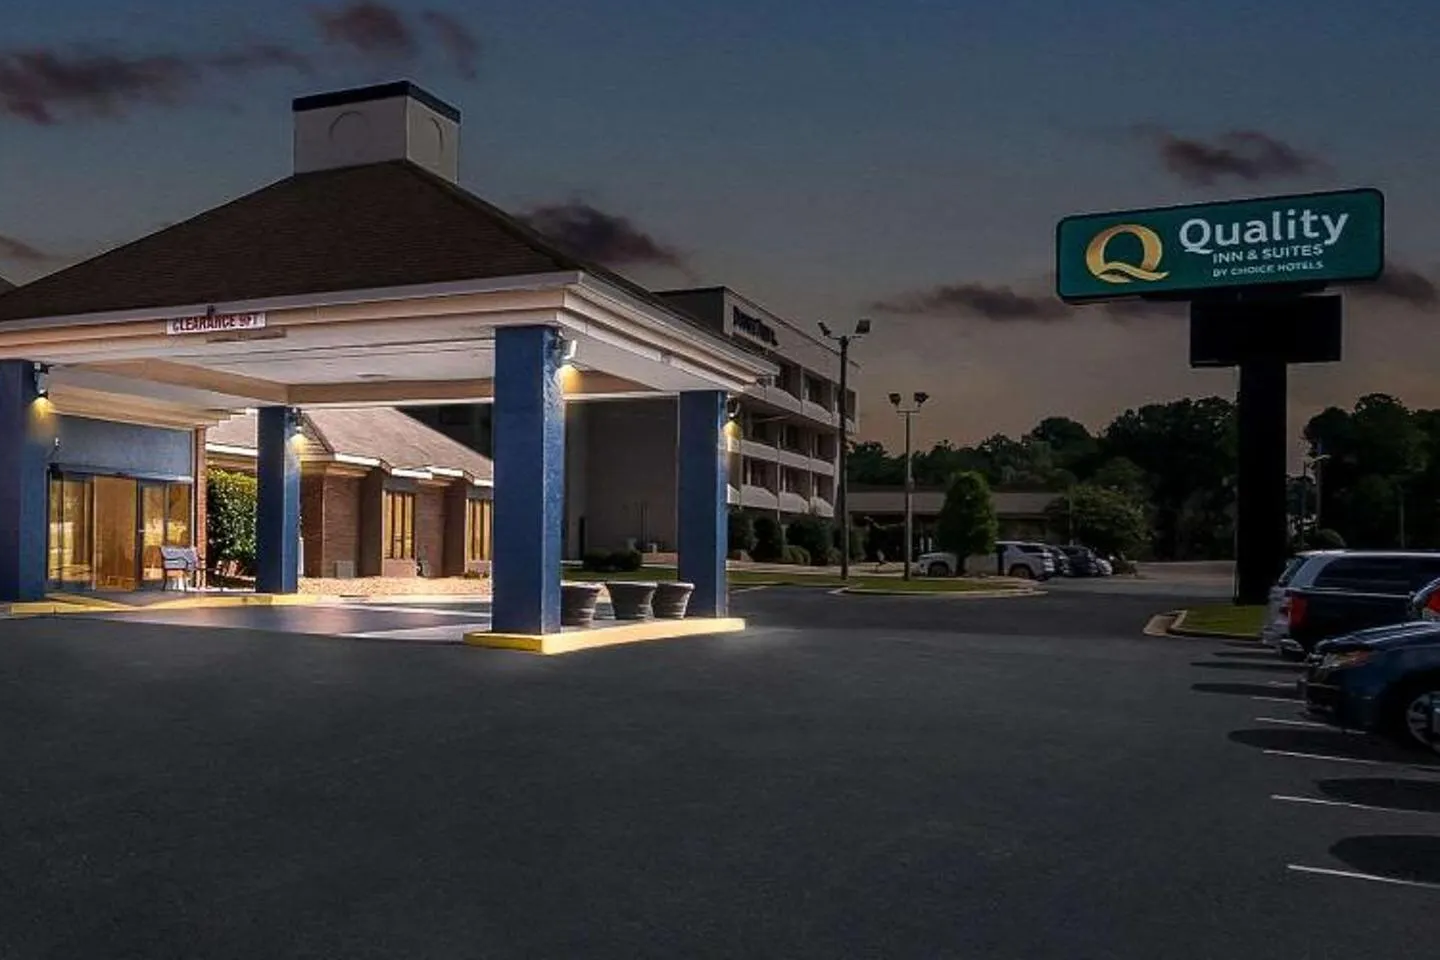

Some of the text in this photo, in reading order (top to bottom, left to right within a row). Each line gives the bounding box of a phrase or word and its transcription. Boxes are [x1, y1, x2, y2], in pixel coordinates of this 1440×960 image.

[1179, 209, 1349, 254] Quality
[1213, 243, 1324, 265] INN & SUITES
[1213, 260, 1324, 278] BY CHOICE HOTELS
[173, 316, 235, 332] CLEARANCE
